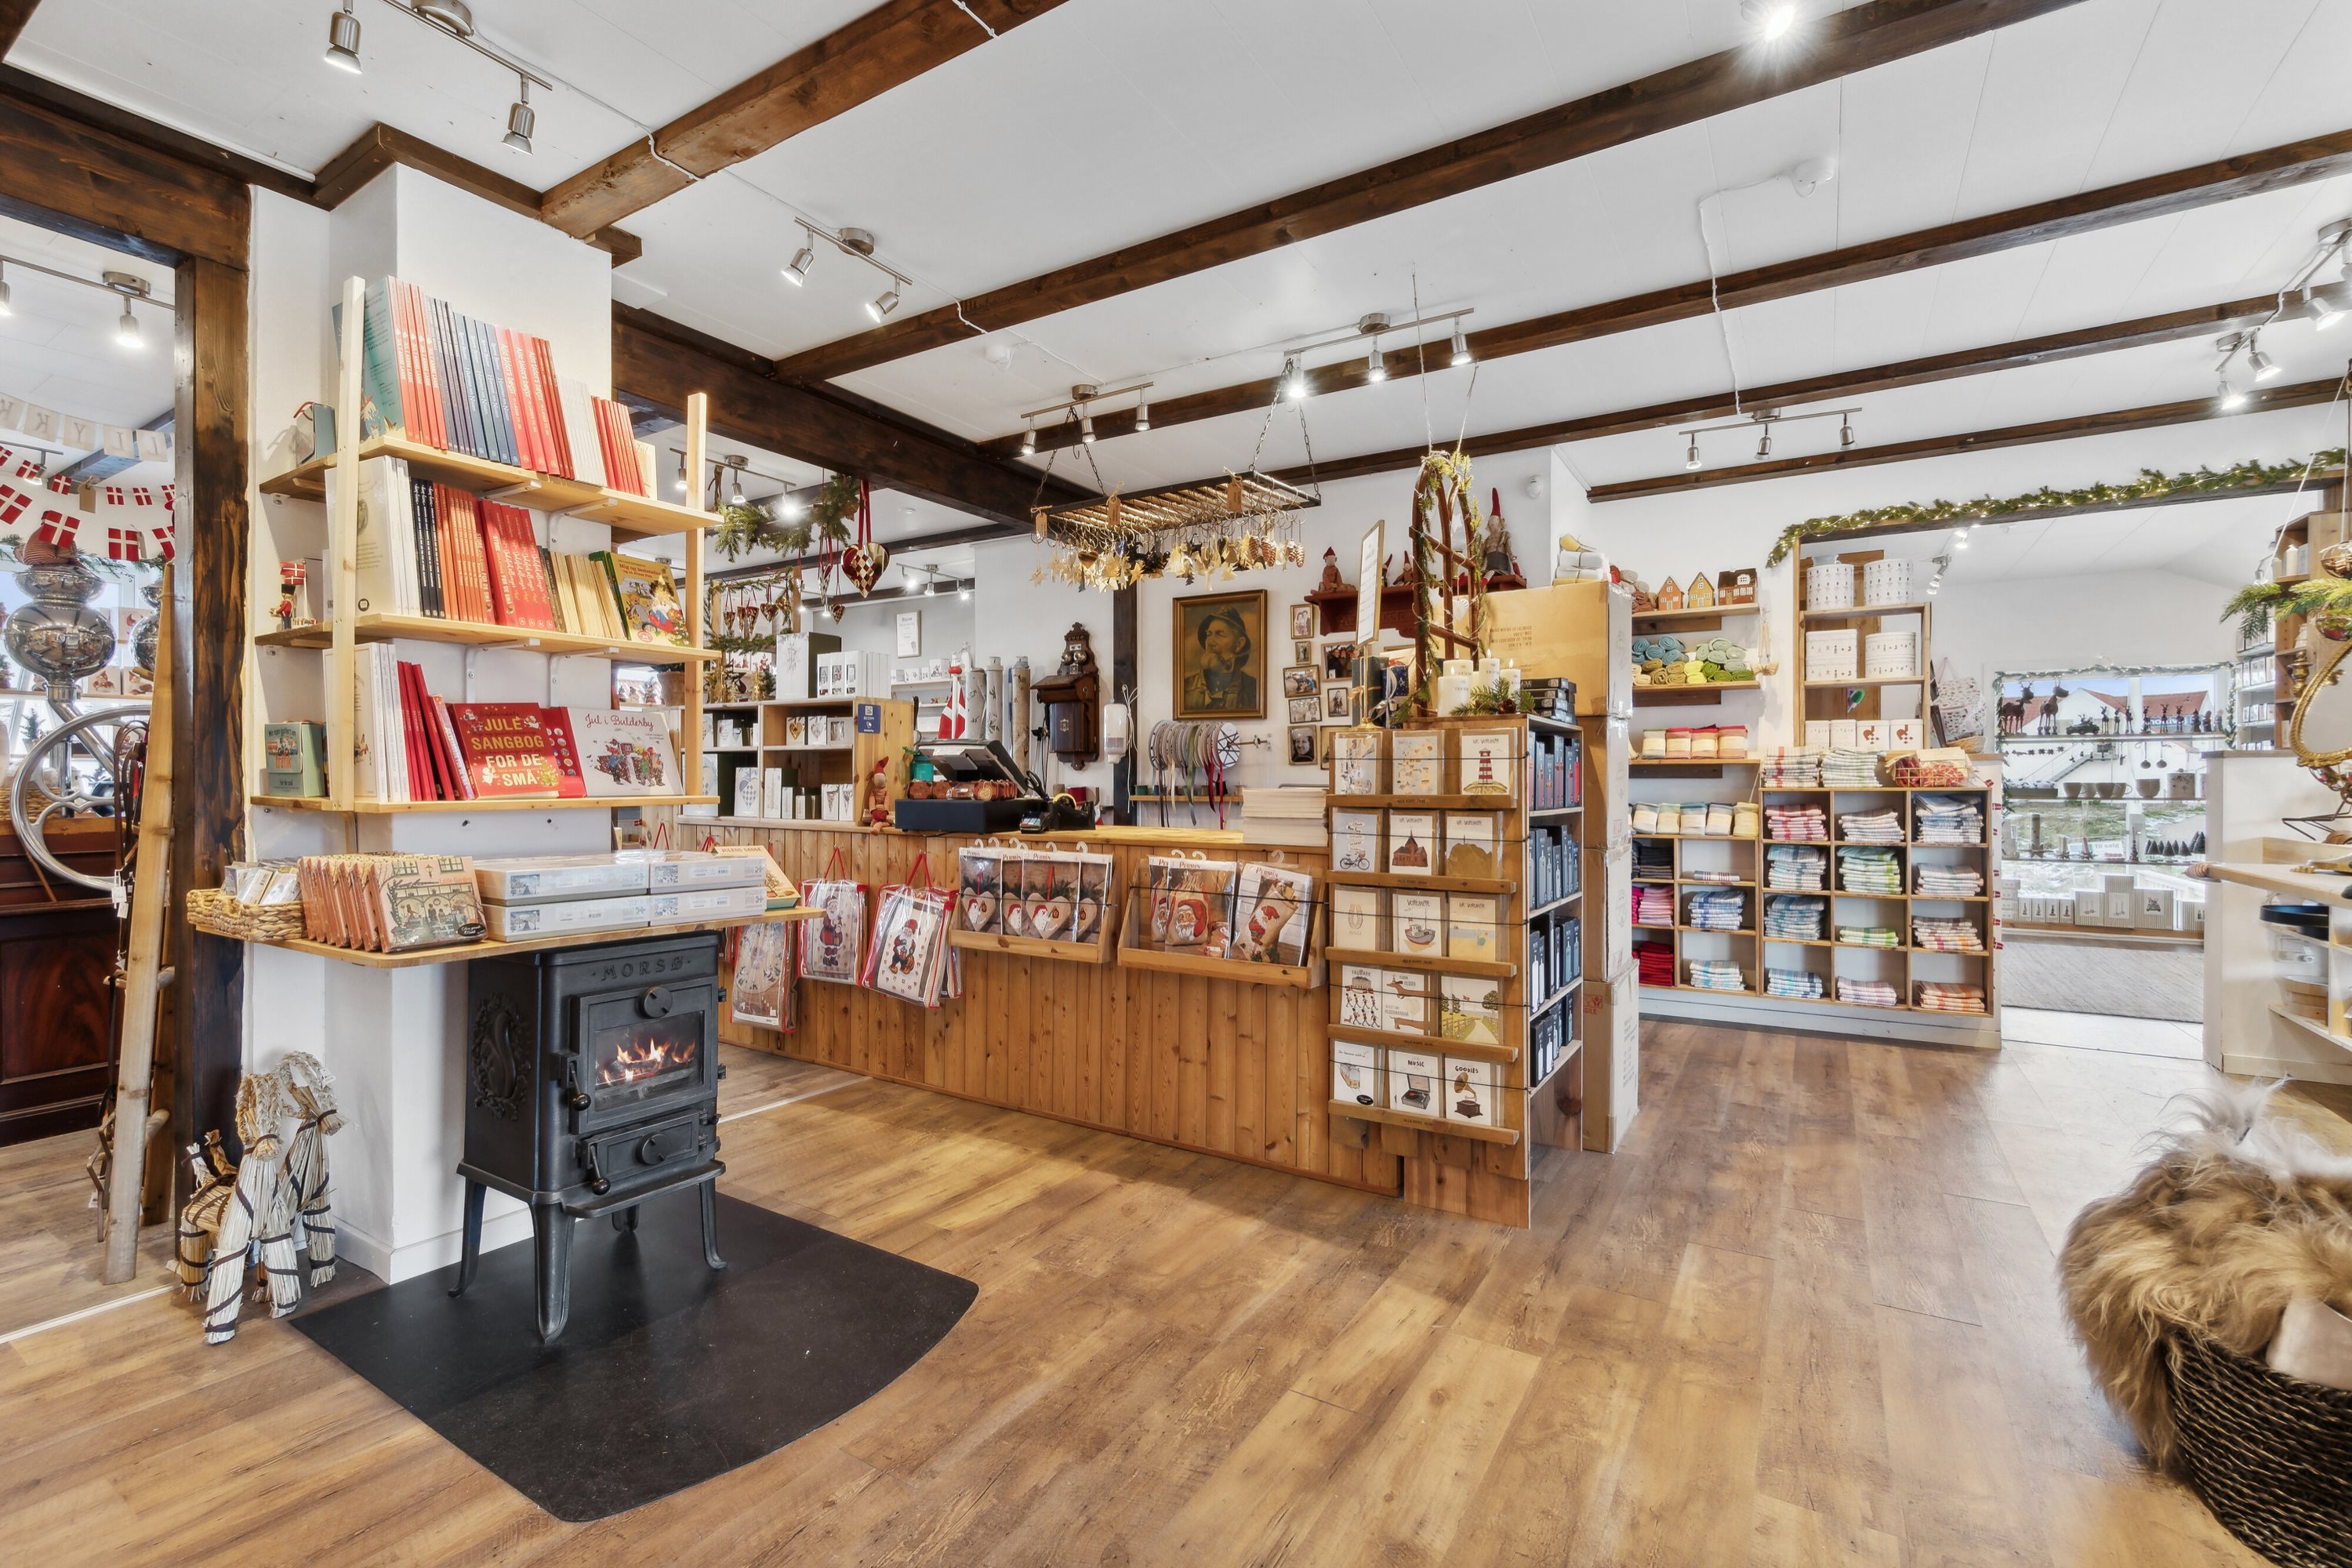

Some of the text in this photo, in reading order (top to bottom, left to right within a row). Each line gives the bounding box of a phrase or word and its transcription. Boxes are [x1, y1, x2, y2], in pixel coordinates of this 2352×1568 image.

[492, 535, 501, 552] STORE
[504, 593, 513, 604] SMÅ
[484, 718, 523, 731] JULE
[586, 713, 654, 731] Jul i Bulderby
[471, 735, 544, 750] SANGBOG
[485, 753, 543, 768] FOR DE
[502, 768, 538, 786] SMÅ
[601, 956, 684, 981] MORSØ
